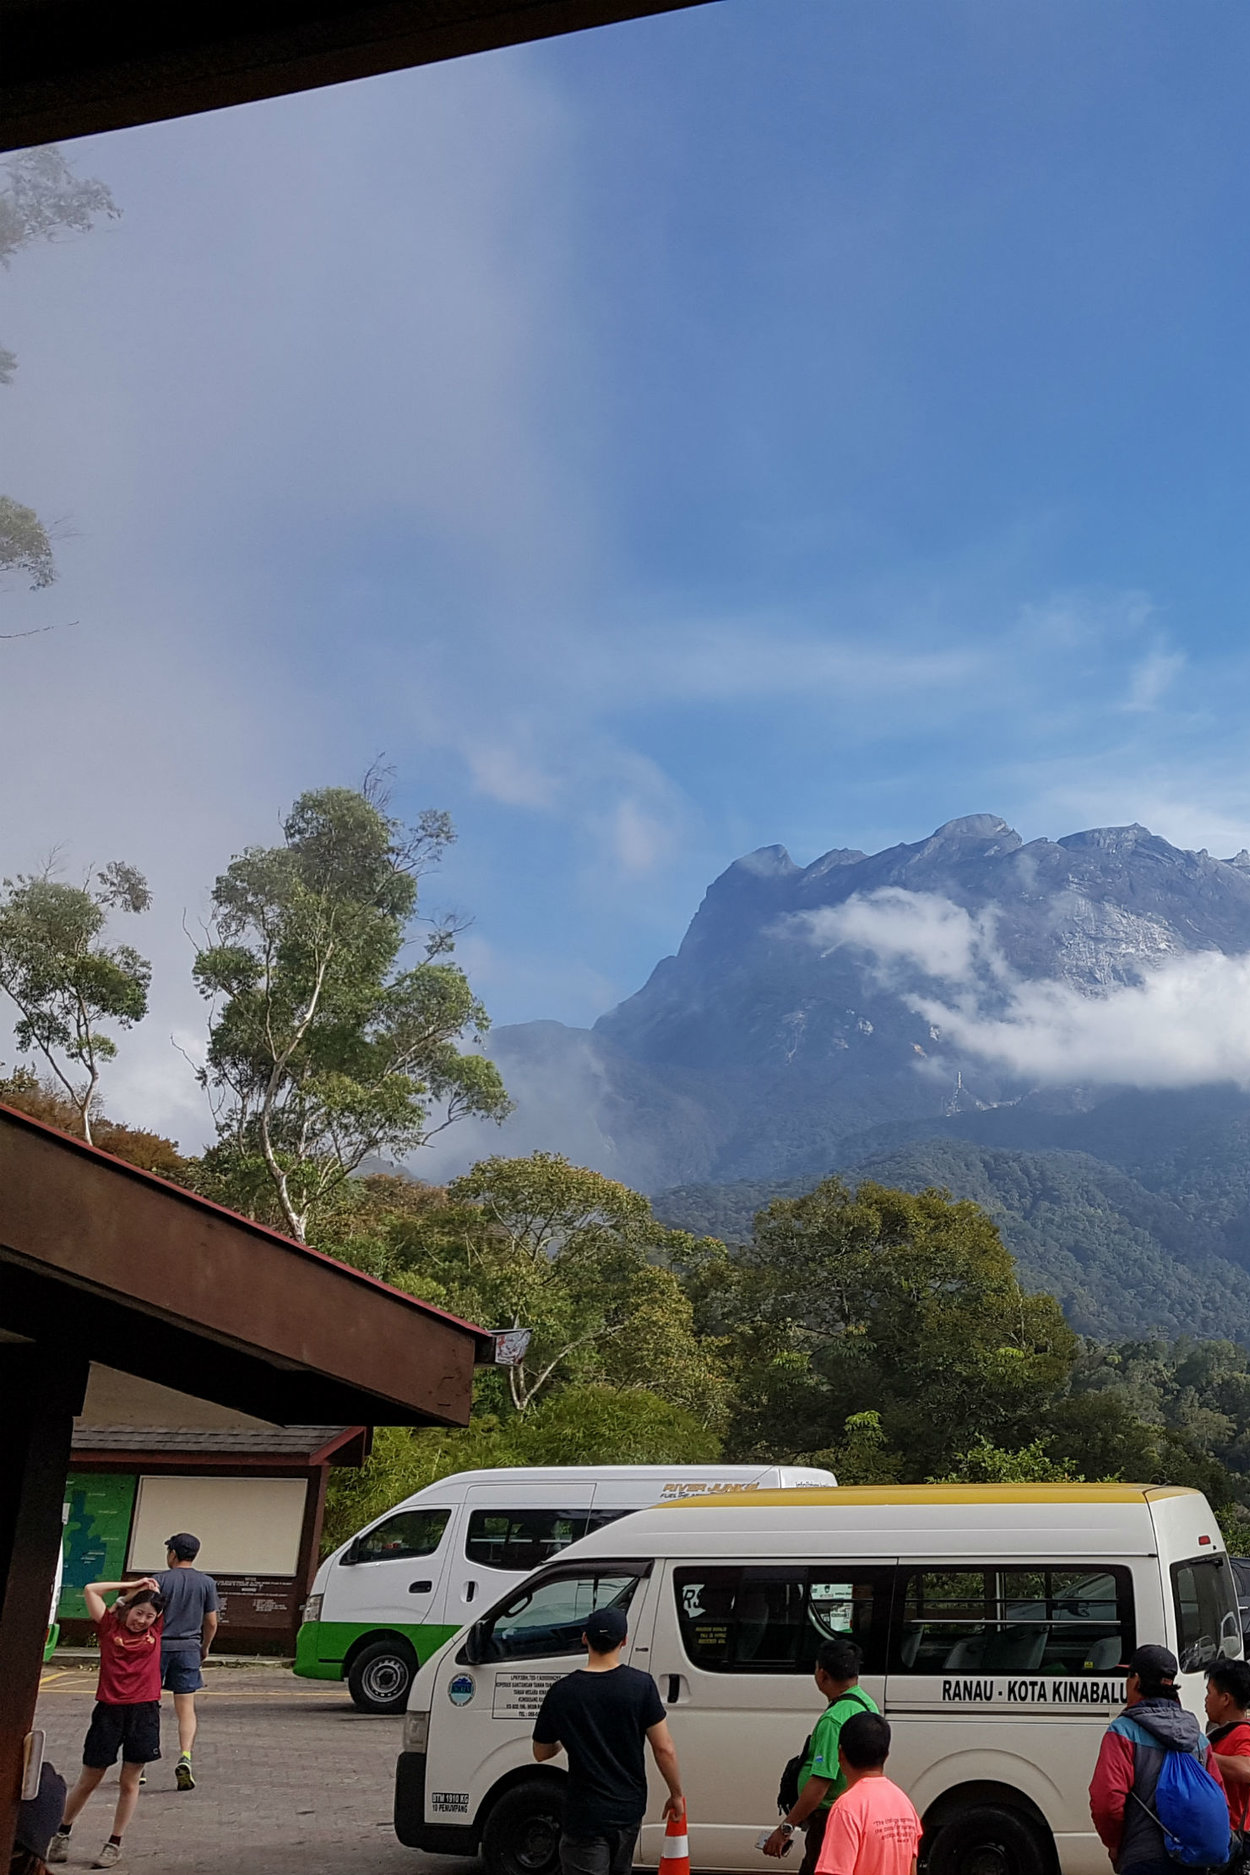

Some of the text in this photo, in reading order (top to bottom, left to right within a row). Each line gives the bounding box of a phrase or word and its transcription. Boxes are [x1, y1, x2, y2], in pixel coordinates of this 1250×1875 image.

[663, 1483, 707, 1492] RIVER
[942, 1680, 994, 1701] RANAU
[1007, 1681, 1048, 1702] KOTA
[1052, 1681, 1128, 1703] KINABALU
[460, 1795, 469, 1803] KG
[439, 1804, 468, 1813] PENUMPANG
